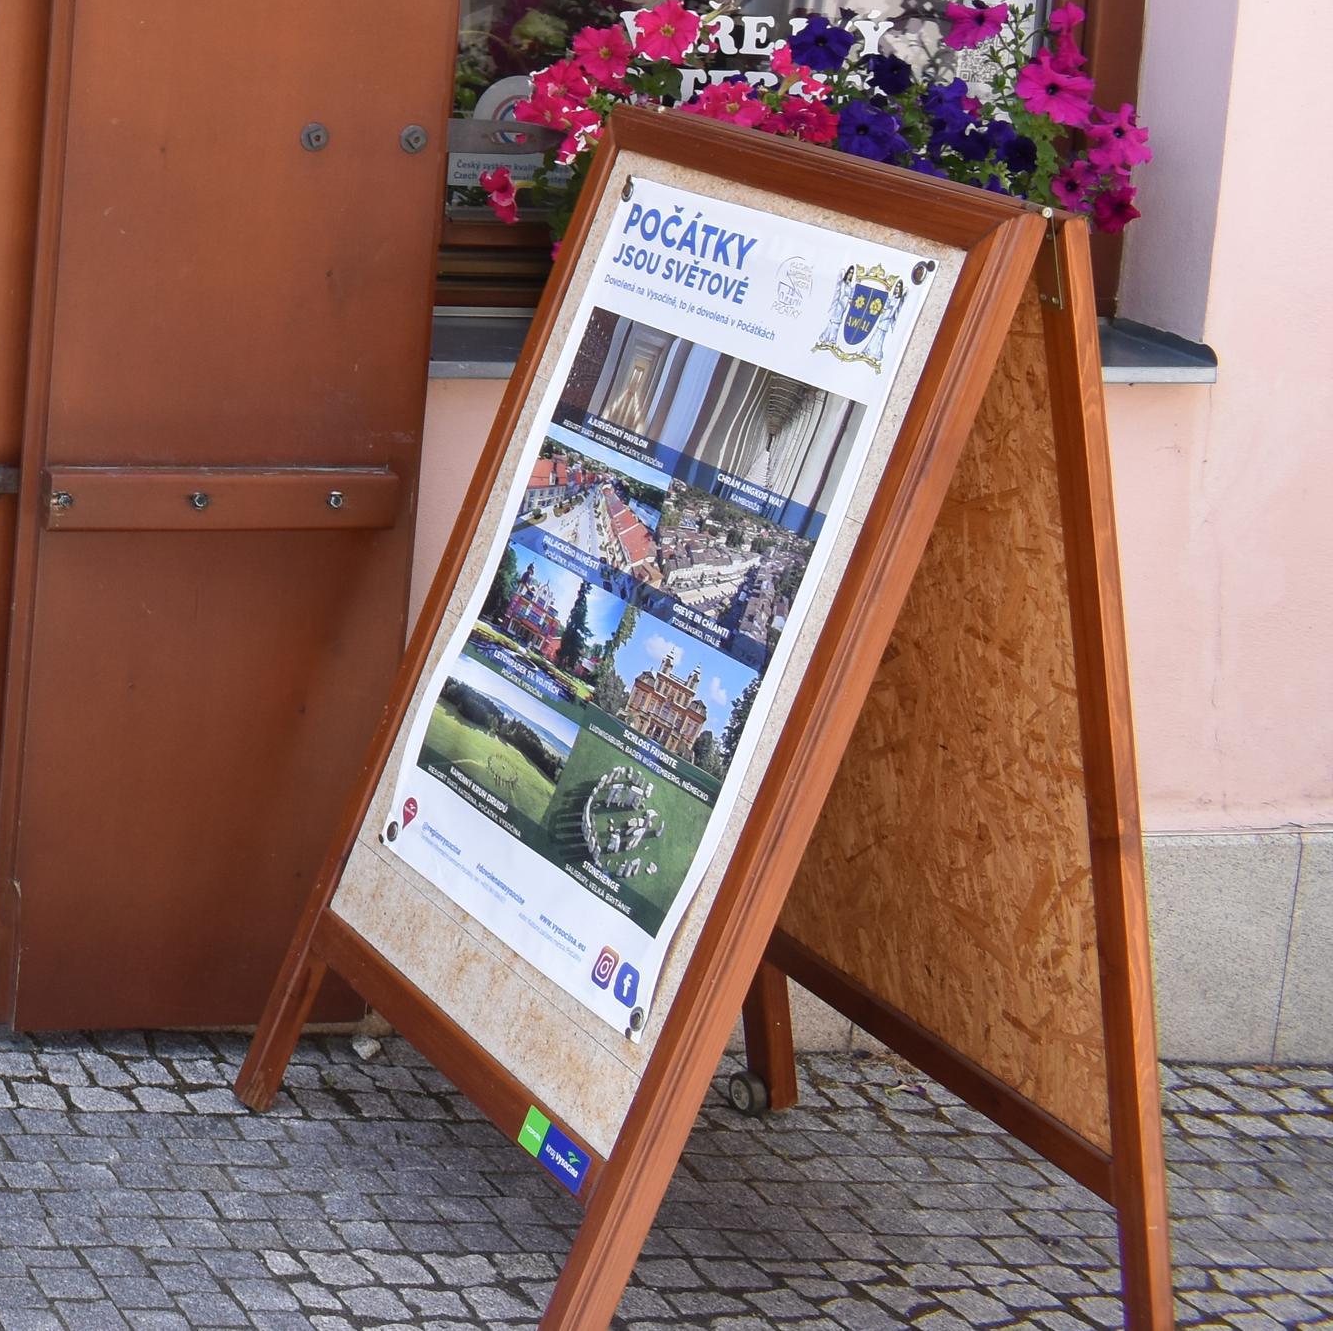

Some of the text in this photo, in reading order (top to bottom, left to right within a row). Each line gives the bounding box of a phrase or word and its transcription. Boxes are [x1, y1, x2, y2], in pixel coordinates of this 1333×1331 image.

[621, 204, 758, 270] POČÁTKY
[612, 243, 663, 276] JSOU
[663, 257, 750, 305] SVĚTOVÉ
[604, 274, 636, 295] Dovolená
[636, 285, 645, 297] na
[646, 285, 677, 310] Vysočině,
[678, 300, 687, 311] to
[688, 301, 697, 317] je
[697, 304, 730, 326] dovolená
[736, 318, 776, 342] Počátkách
[563, 419, 582, 433] RESORT
[639, 453, 664, 469] VYSOČINA
[623, 431, 649, 450] PAVILON
[717, 473, 786, 508] CHRÁM ANGKOR WAT
[543, 535, 600, 570] PALACKÉHO NÁMĚSTÍ
[672, 603, 730, 638] GREVE IN CHIANTI
[536, 674, 560, 696] VOJTĚCH
[588, 723, 625, 754] LUDWIGSBURG,
[625, 744, 643, 763] BADEN
[682, 780, 709, 802] NĚMECKO
[623, 729, 678, 770] SCHLOSS FAVORITE
[450, 766, 509, 814] KAMENNÝ KRUH DRUIDŮ
[498, 813, 522, 838] VYSOČINA
[565, 863, 632, 915] SALISBURY, VELKÁ BRITÁNIE
[583, 860, 621, 892] STONEHENGE
[539, 913, 587, 953] www.vysocina.eu
